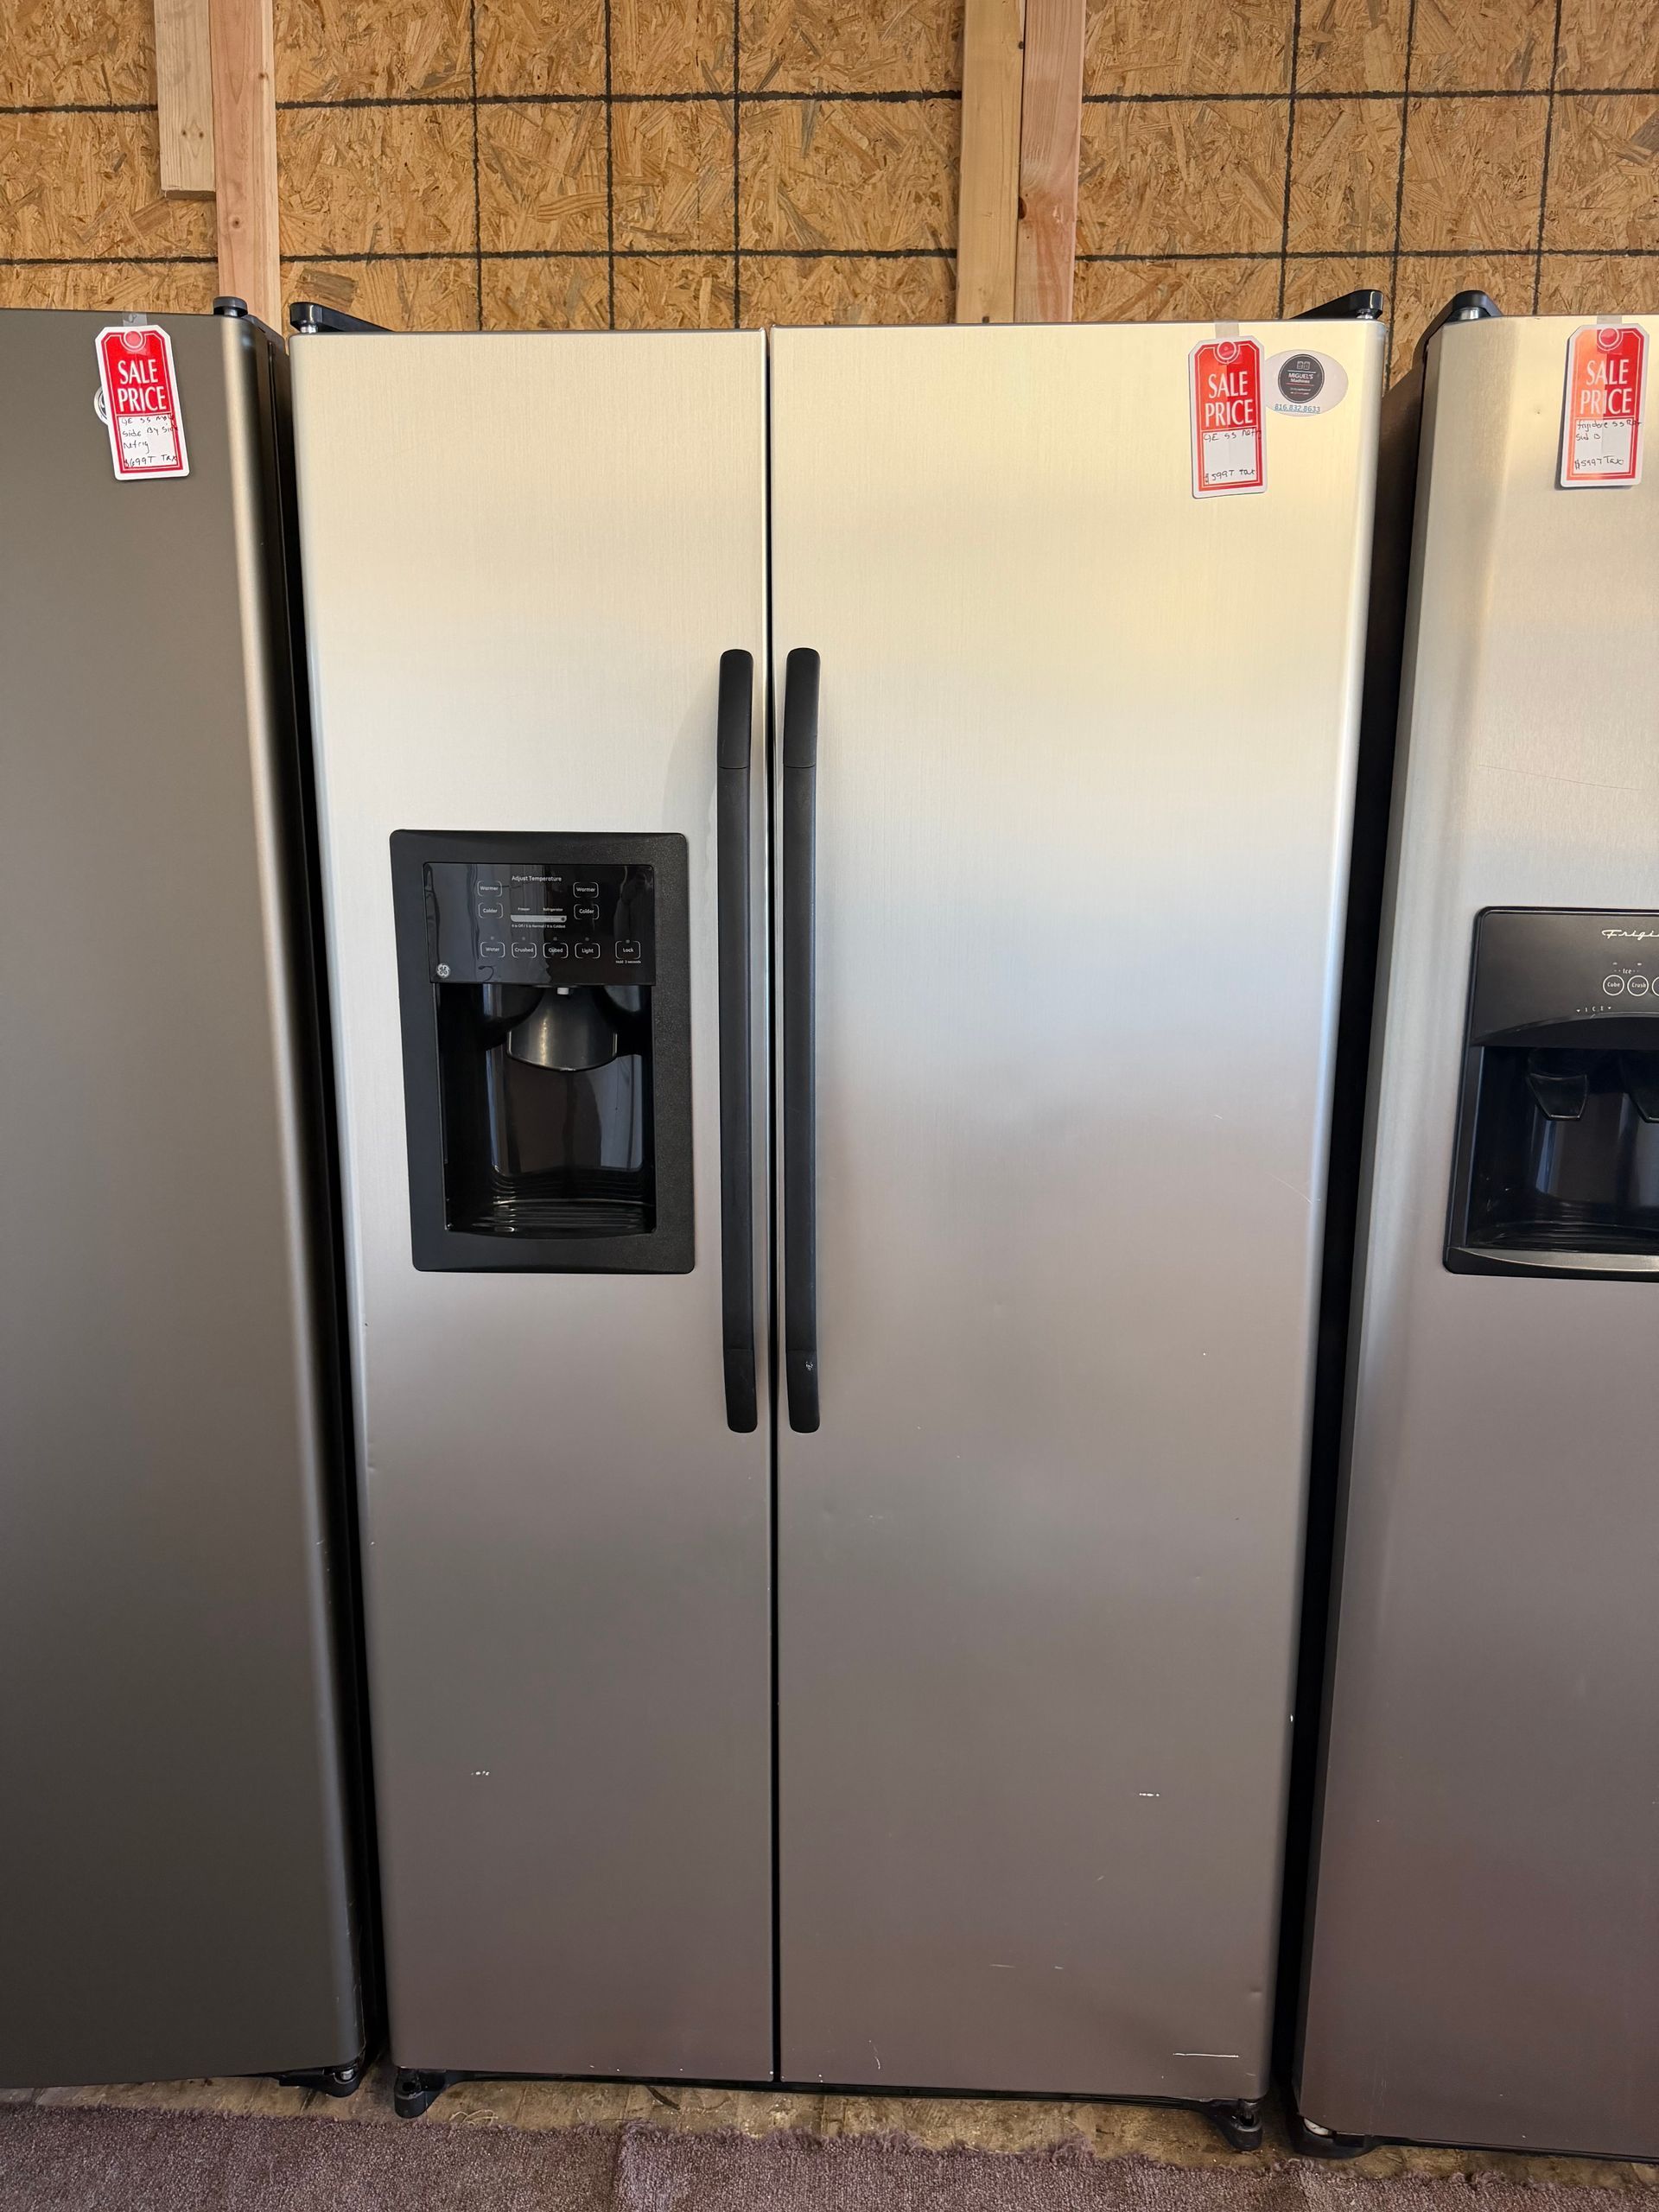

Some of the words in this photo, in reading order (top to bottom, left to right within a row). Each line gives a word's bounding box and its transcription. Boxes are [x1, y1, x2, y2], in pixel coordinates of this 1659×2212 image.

[118, 359, 159, 385] SALE
[1207, 371, 1249, 398] SALE
[1586, 359, 1630, 386] SALE
[118, 386, 168, 412] PRICE
[1580, 388, 1632, 415] PRICE
[1205, 399, 1254, 428] PRICE
